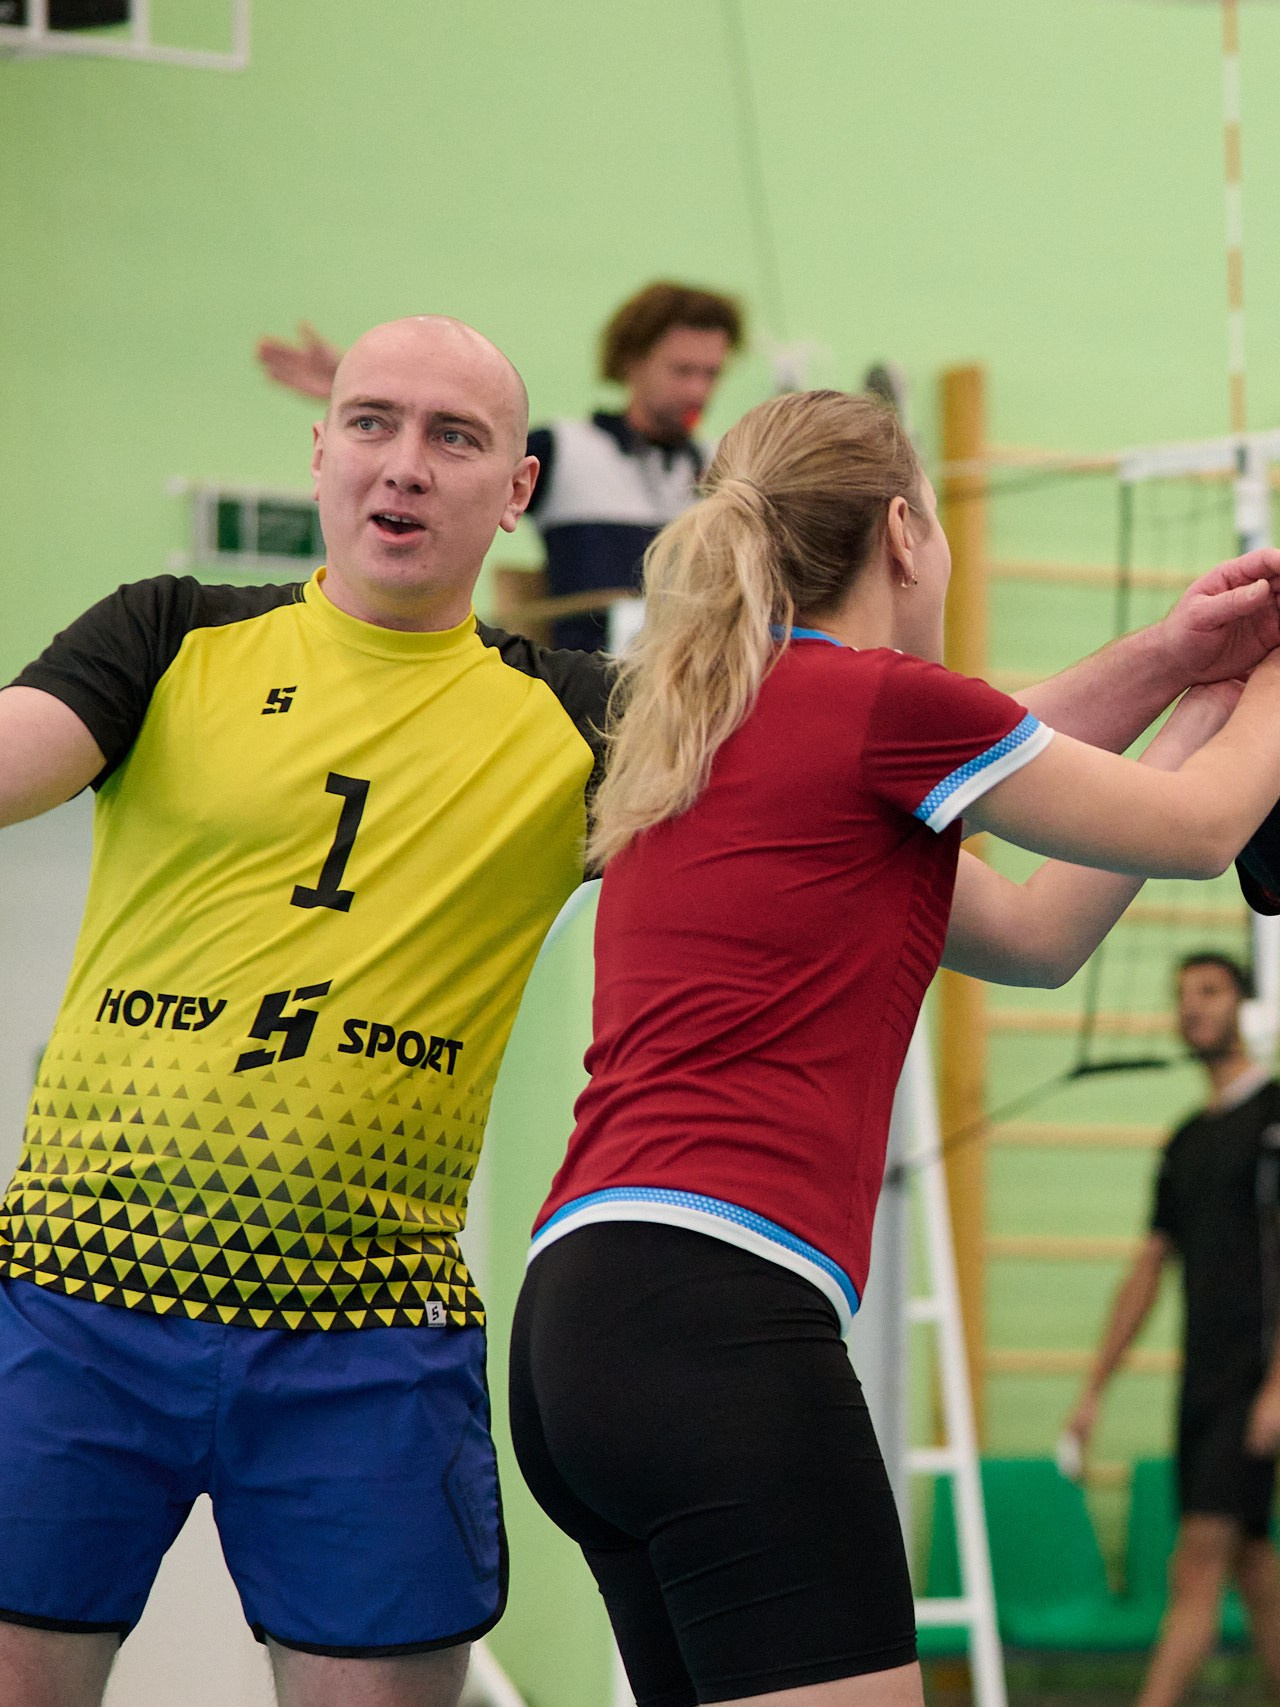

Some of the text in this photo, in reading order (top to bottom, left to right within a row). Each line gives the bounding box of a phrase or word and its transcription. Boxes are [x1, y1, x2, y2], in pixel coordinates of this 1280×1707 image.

[290, 771, 371, 913] 1
[95, 988, 464, 1076] HOTEY SPORT
